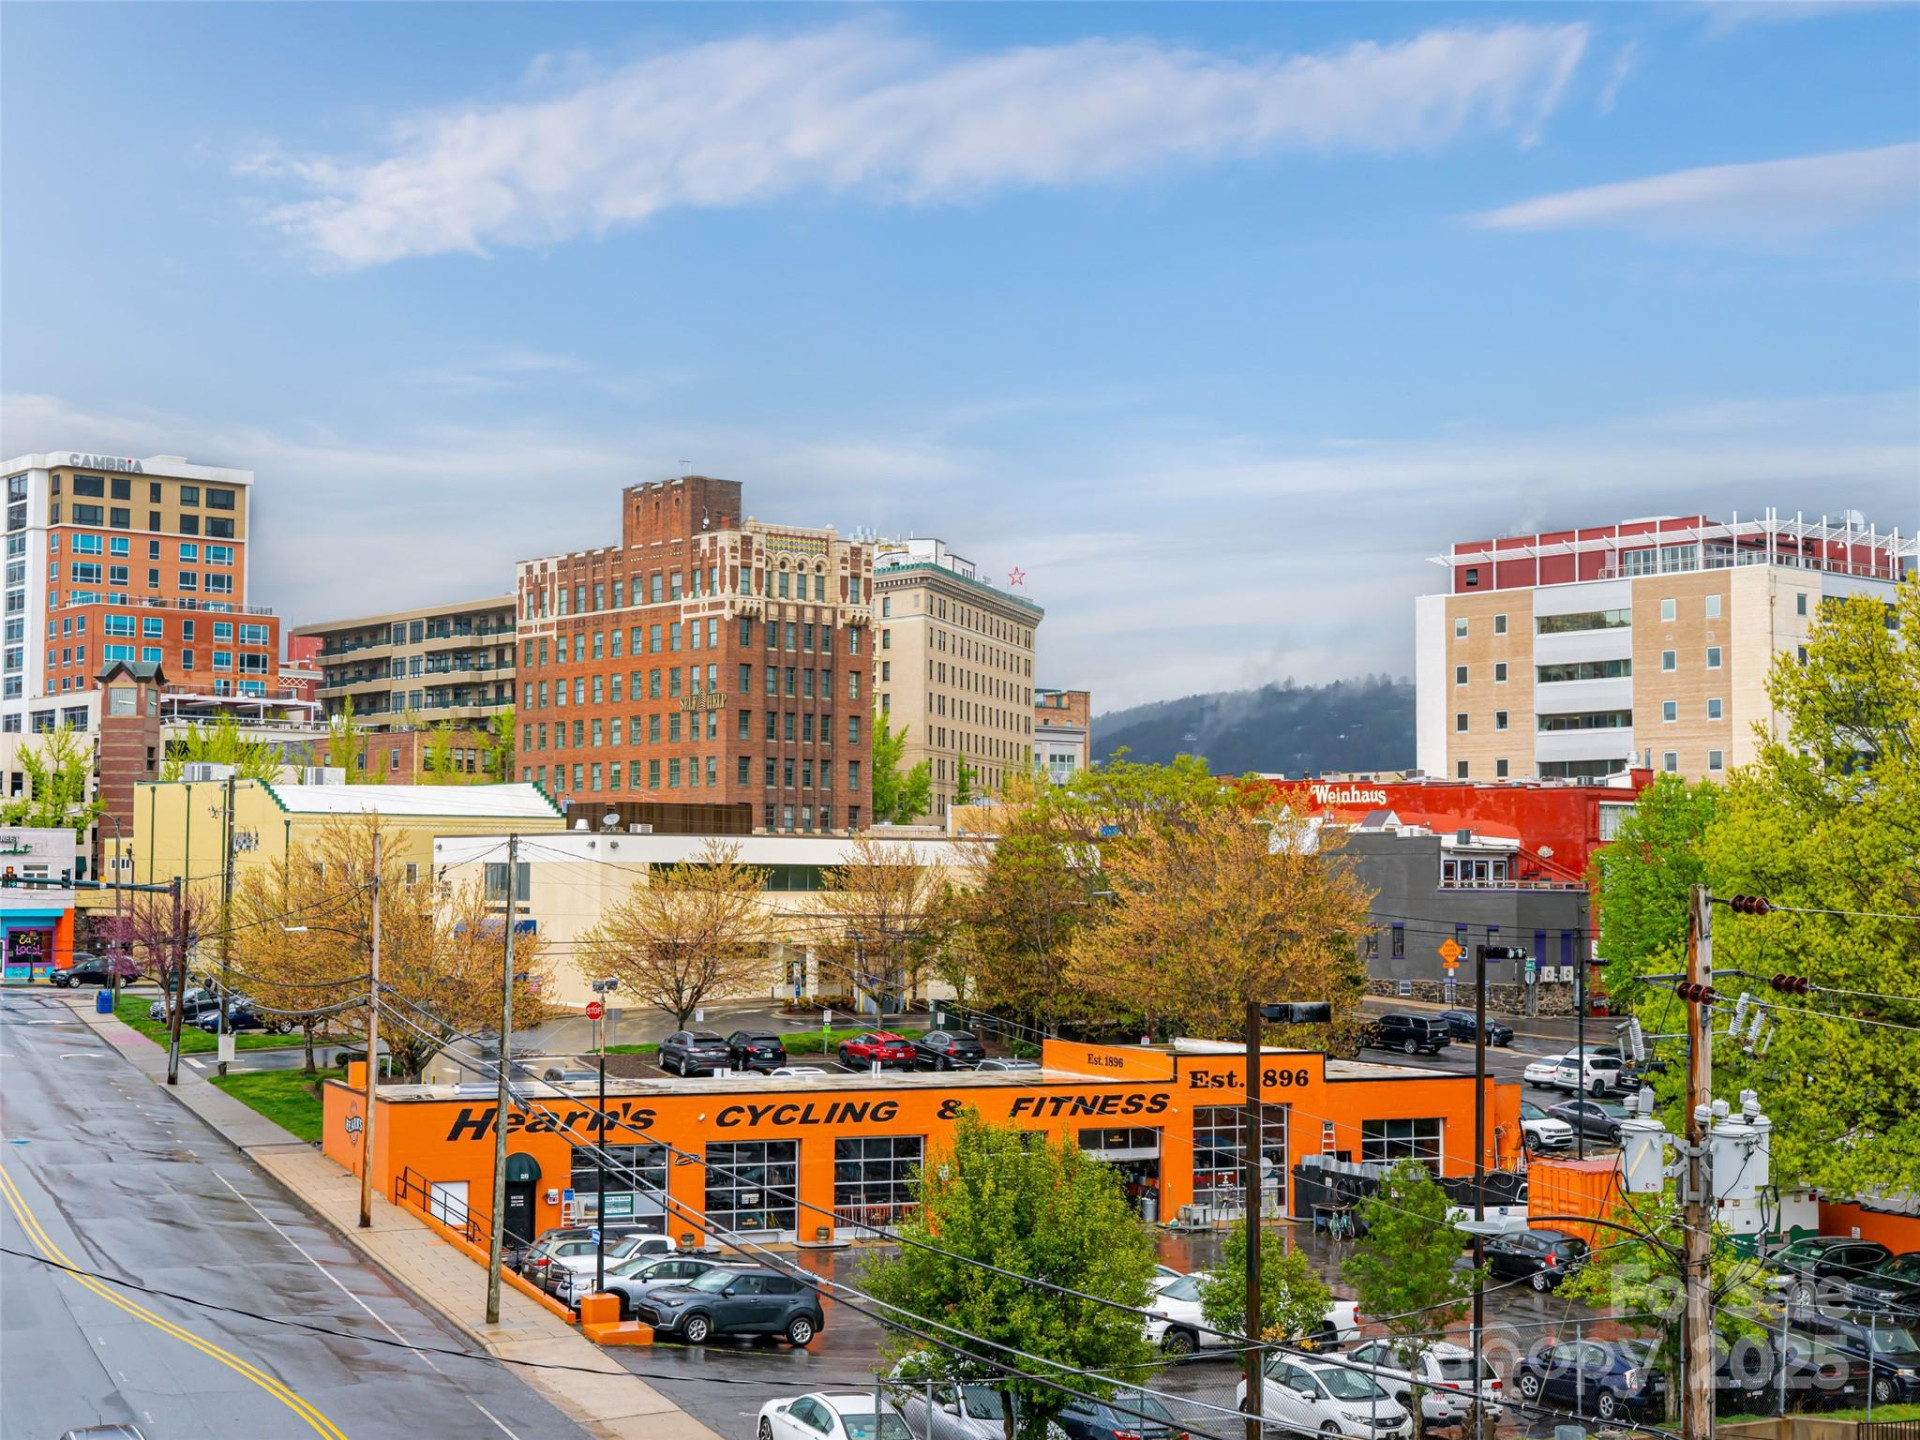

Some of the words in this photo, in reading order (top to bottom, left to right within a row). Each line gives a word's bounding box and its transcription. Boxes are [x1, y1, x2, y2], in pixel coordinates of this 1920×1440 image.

[1310, 784, 1387, 805] Weinhaus
[586, 1006, 602, 1015] STOP
[1087, 1053, 1103, 1066] Est.
[1104, 1055, 1124, 1068] 1896
[1189, 1069, 1245, 1089] Est.
[1257, 1069, 1309, 1088] 896
[446, 1102, 657, 1142] Hearn's
[716, 1100, 899, 1128] CYCLING
[936, 1098, 962, 1120] &
[1008, 1093, 1171, 1118] FITNESS
